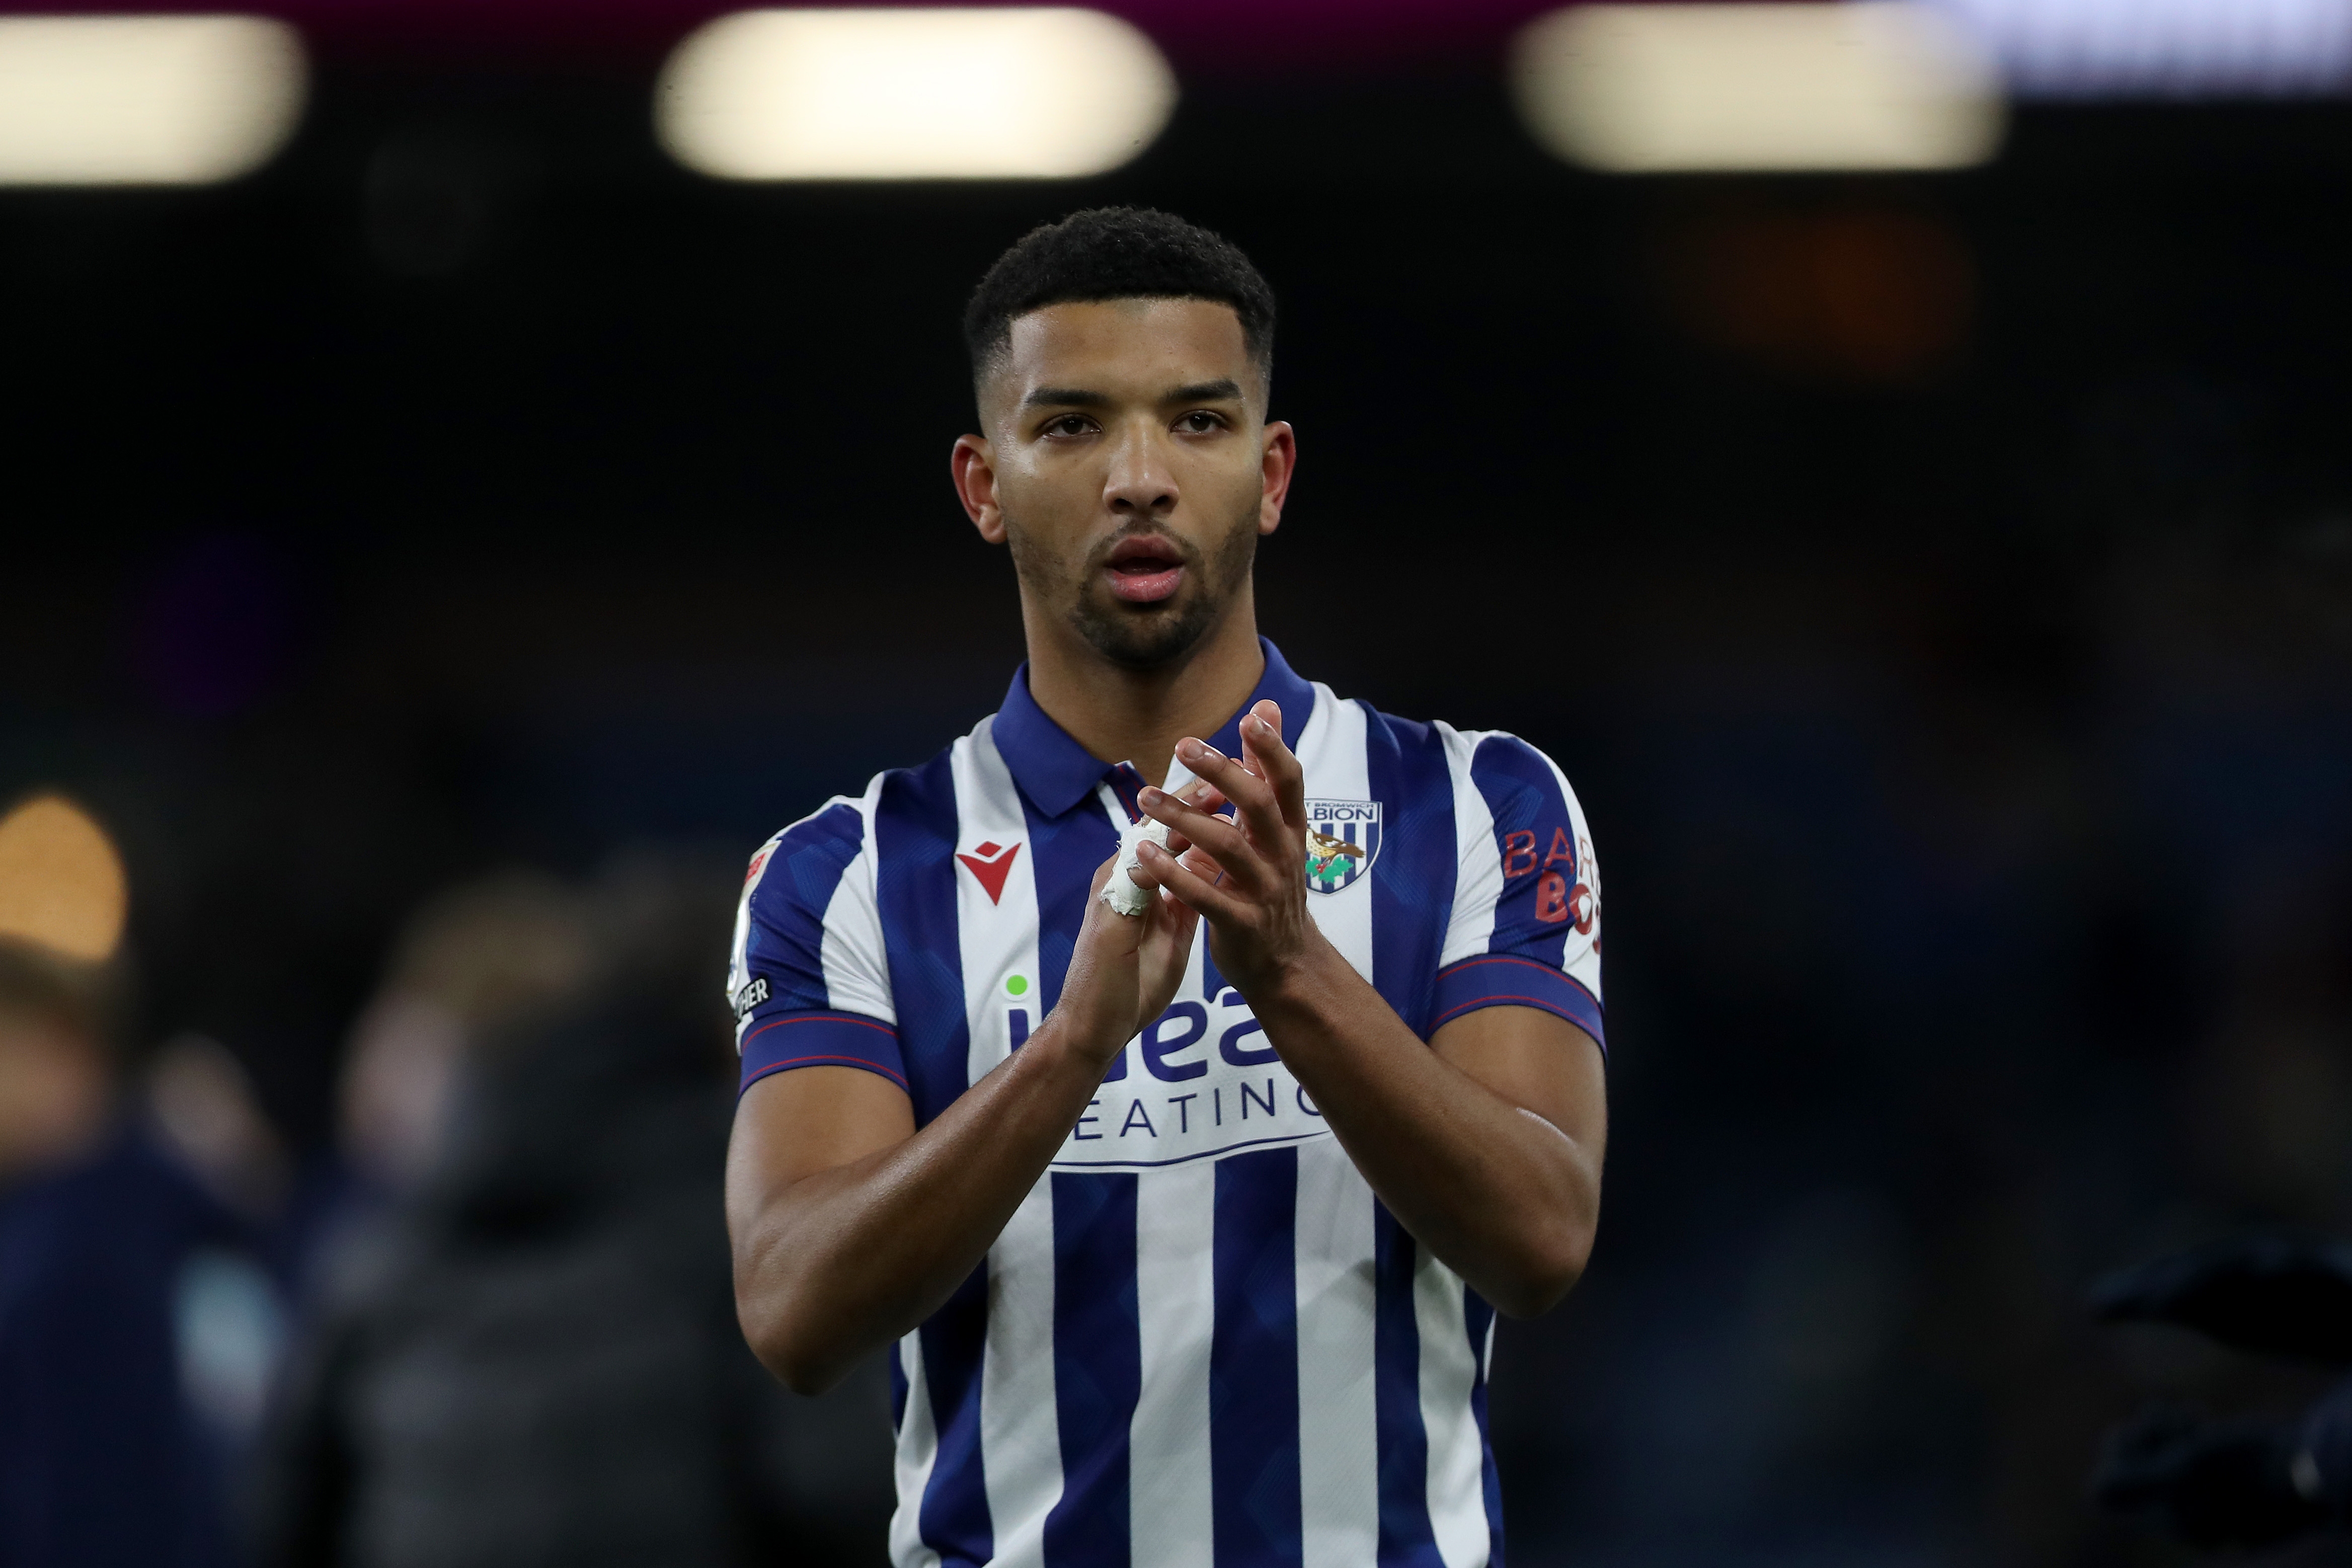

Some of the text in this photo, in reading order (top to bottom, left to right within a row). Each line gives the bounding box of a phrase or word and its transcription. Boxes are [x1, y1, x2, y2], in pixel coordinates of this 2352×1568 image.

[1307, 807, 1373, 820] BION
[1504, 827, 1596, 888] BAR
[1535, 870, 1599, 941] BO
[736, 978, 769, 1020] HER
